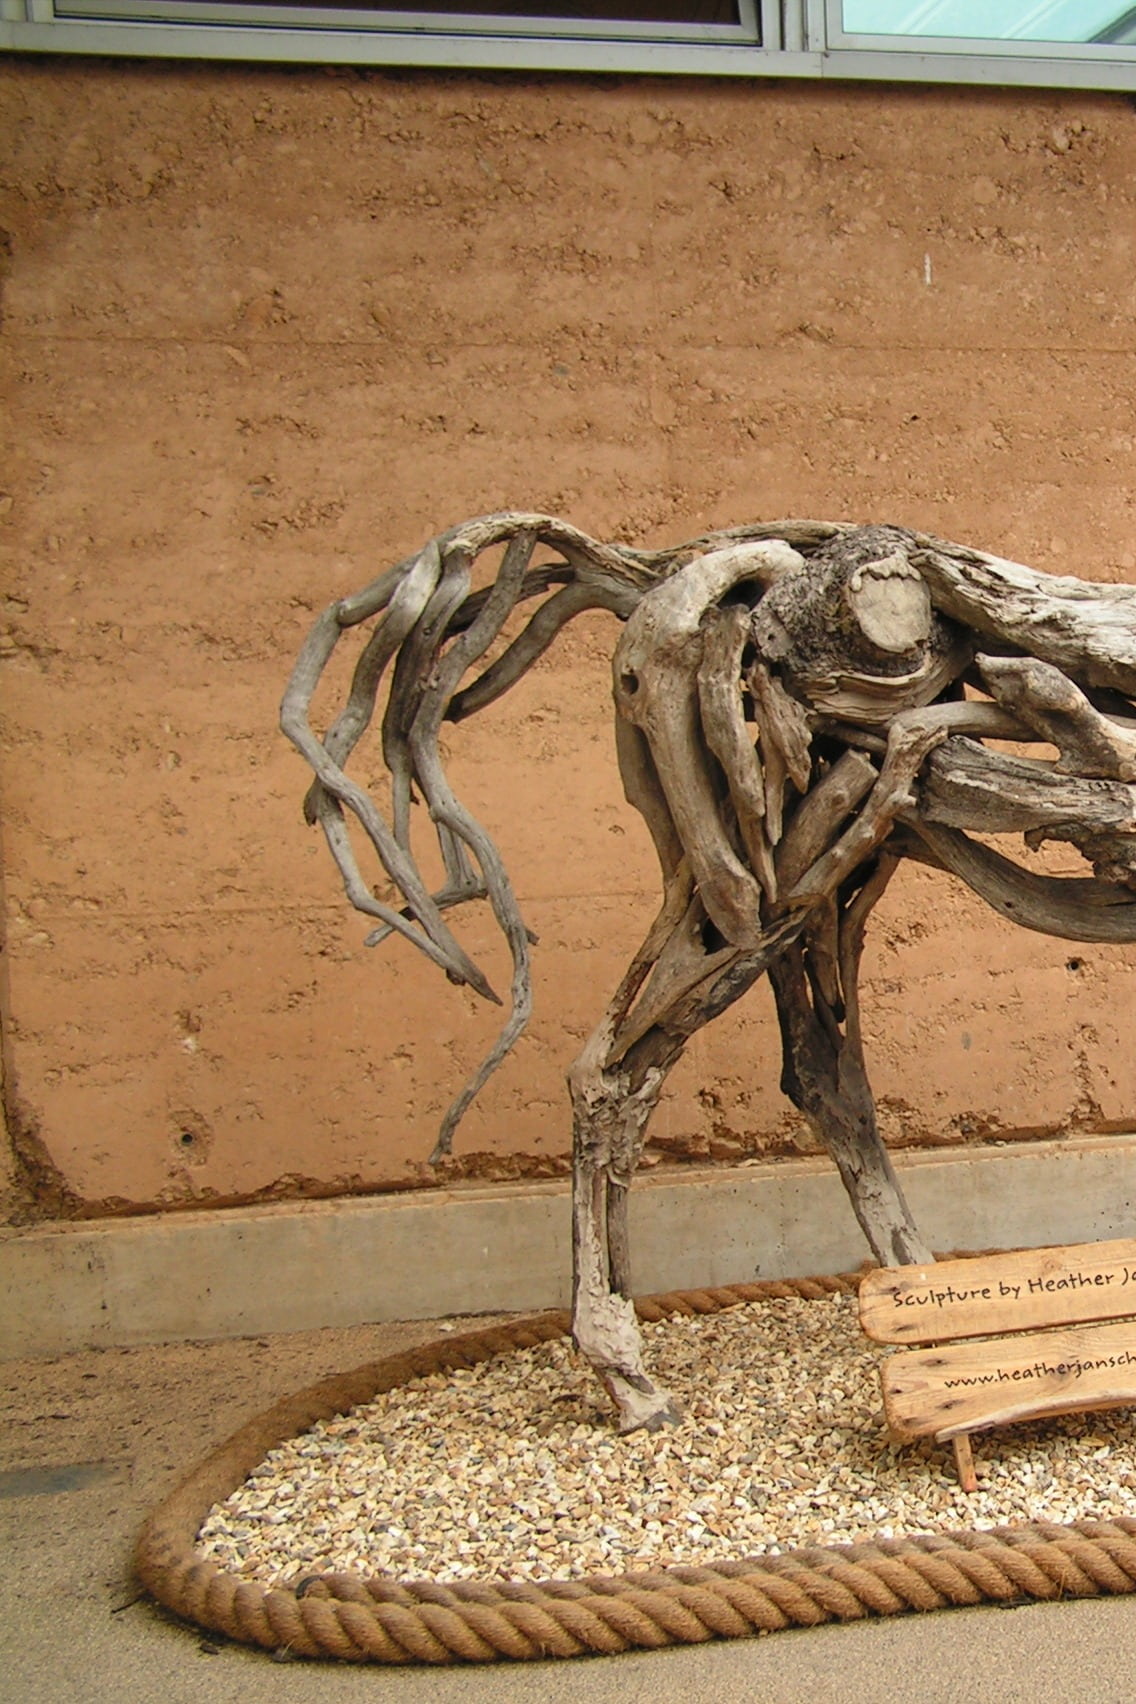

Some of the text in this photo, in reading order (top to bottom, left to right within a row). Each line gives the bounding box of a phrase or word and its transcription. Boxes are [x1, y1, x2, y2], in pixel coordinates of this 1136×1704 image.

[893, 1285, 991, 1308] Sculpture
[999, 1281, 1021, 1299] by
[1027, 1273, 1114, 1294] Heather
